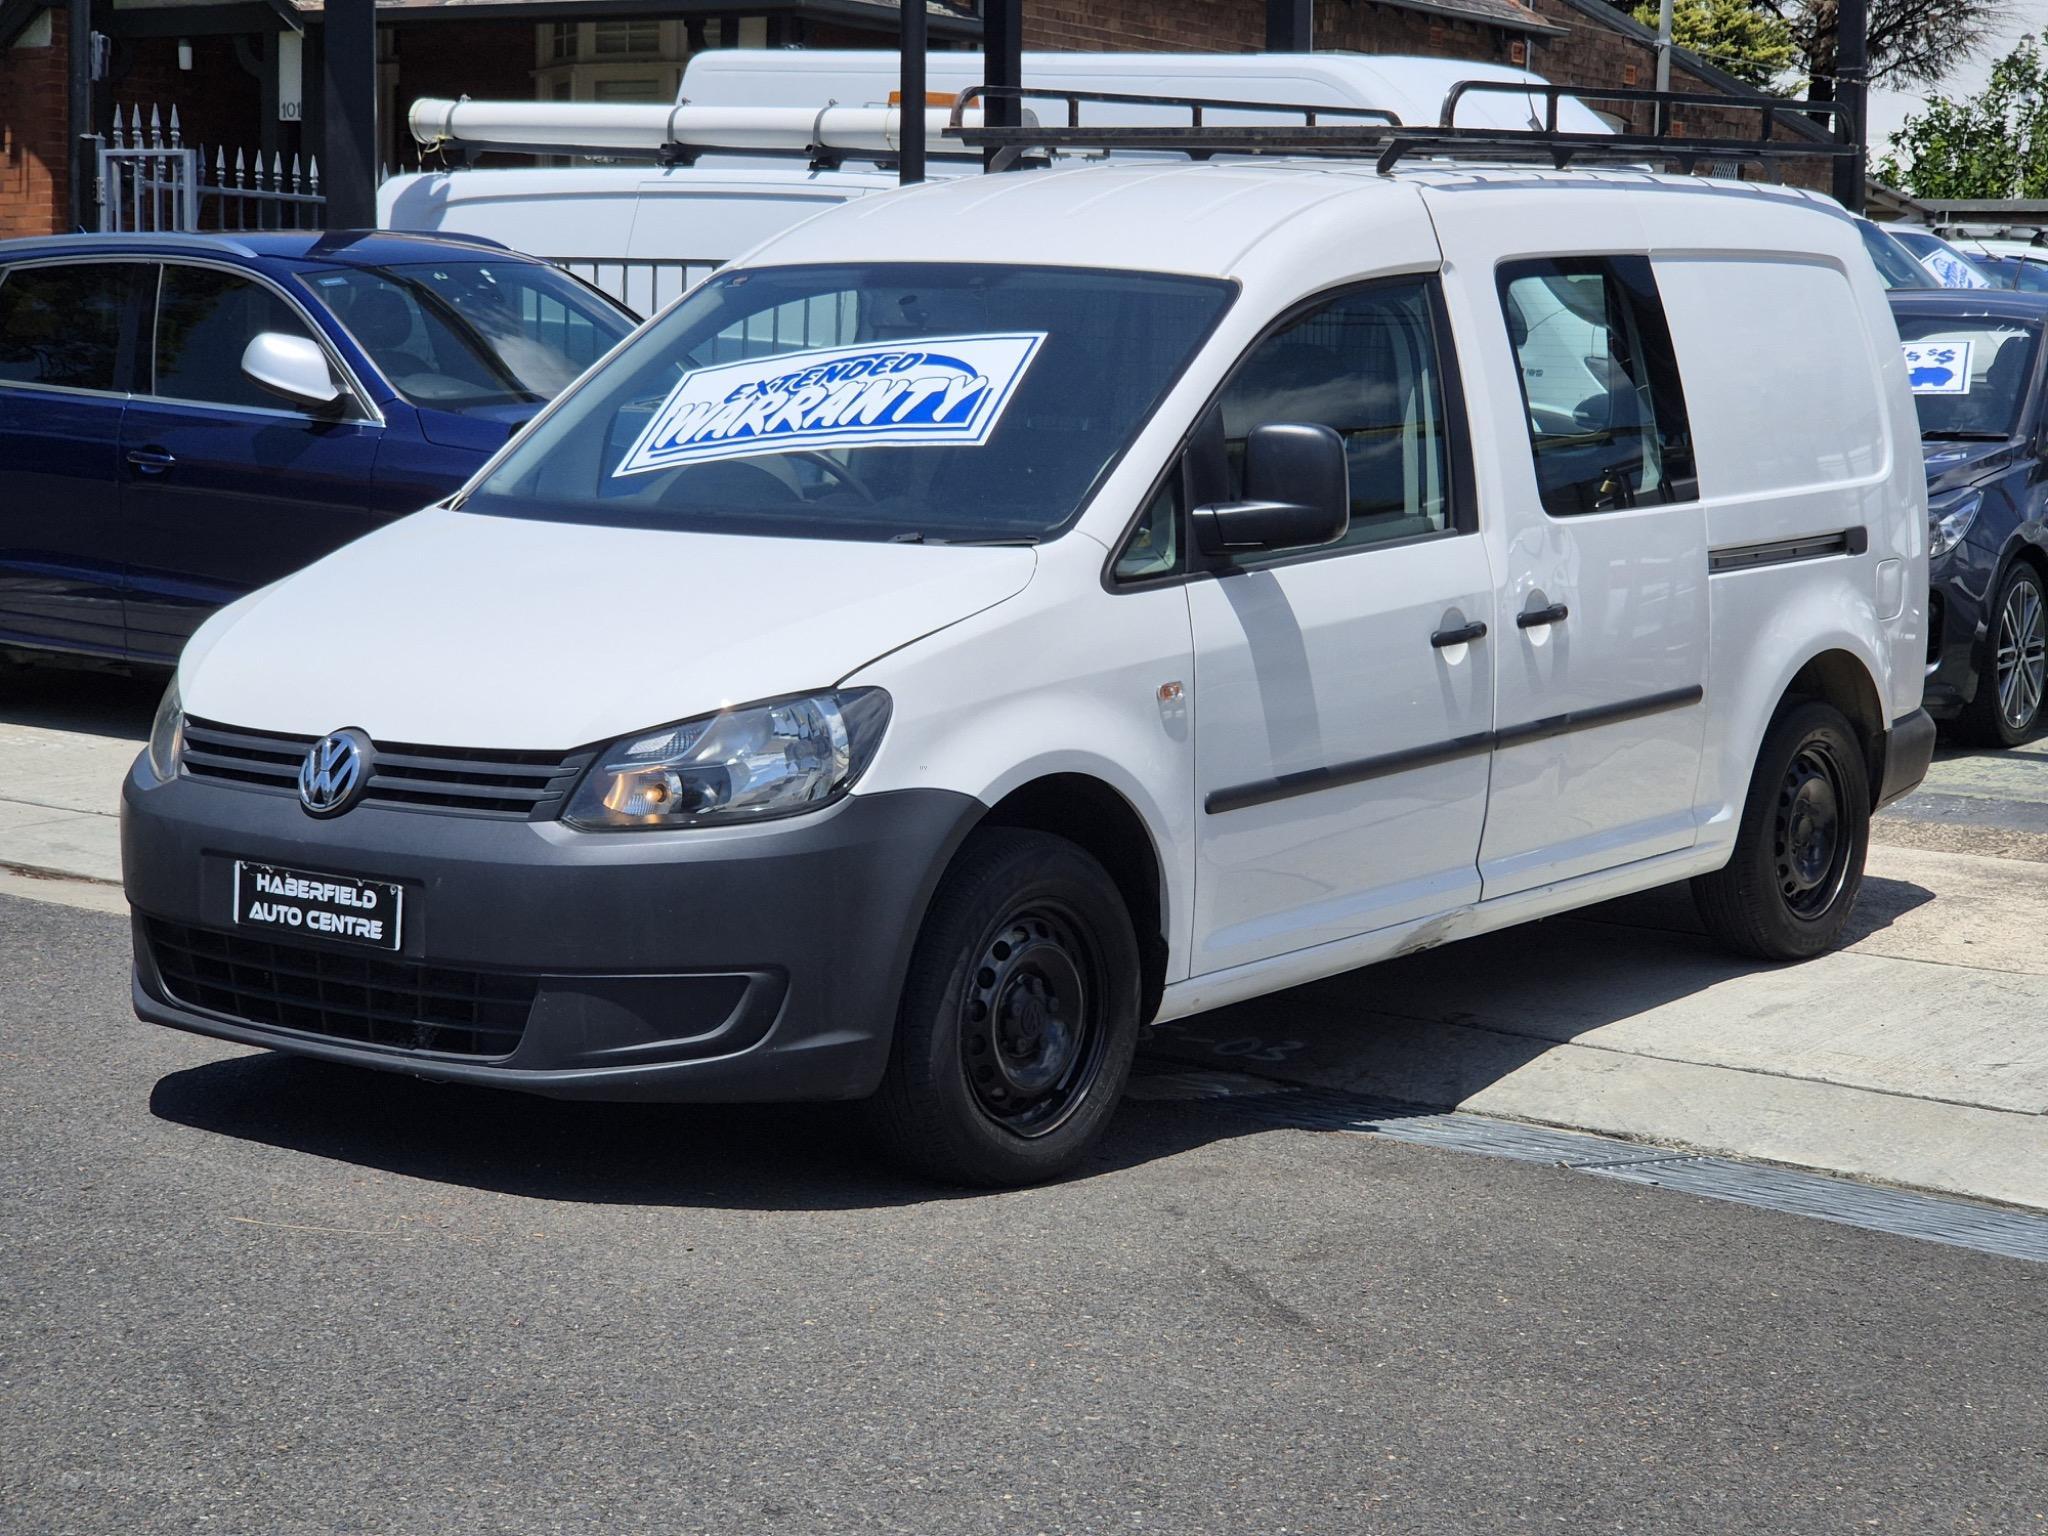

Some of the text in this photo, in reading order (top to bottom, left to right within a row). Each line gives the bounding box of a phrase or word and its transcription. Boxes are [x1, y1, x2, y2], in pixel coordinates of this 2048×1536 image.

[281, 101, 302, 119] 101
[723, 351, 926, 404] EXTENDED
[652, 374, 991, 450] WARRANTY
[256, 872, 378, 909] HABERFIELD
[248, 901, 384, 940] AUTO CENTRE
